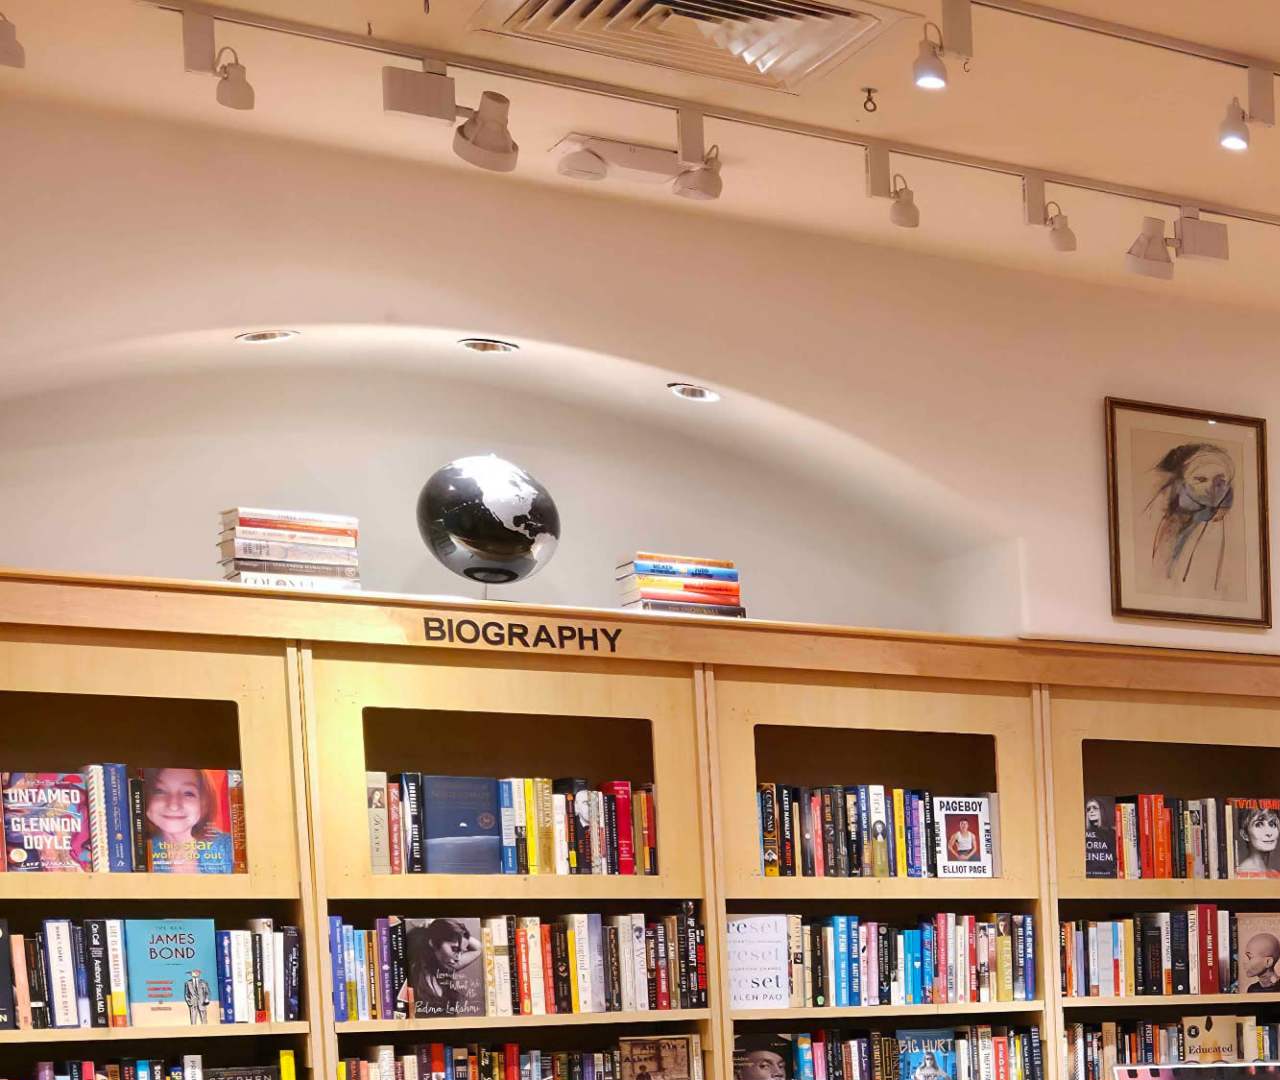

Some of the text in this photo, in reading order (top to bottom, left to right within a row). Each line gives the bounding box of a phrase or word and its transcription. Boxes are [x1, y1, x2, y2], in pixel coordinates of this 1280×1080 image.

[423, 616, 622, 653] BIOGRAPHY
[7, 788, 81, 806] UNTAMED
[939, 800, 982, 812] PAGEBOY
[11, 817, 81, 833] GLENNON
[23, 835, 72, 850] DOYLE
[943, 866, 987, 874] ELLIOT PAGE
[150, 933, 195, 945] JAMES
[150, 947, 195, 960] BOND
[415, 1000, 445, 1014] Padma
[1188, 1043, 1233, 1056] Educated
